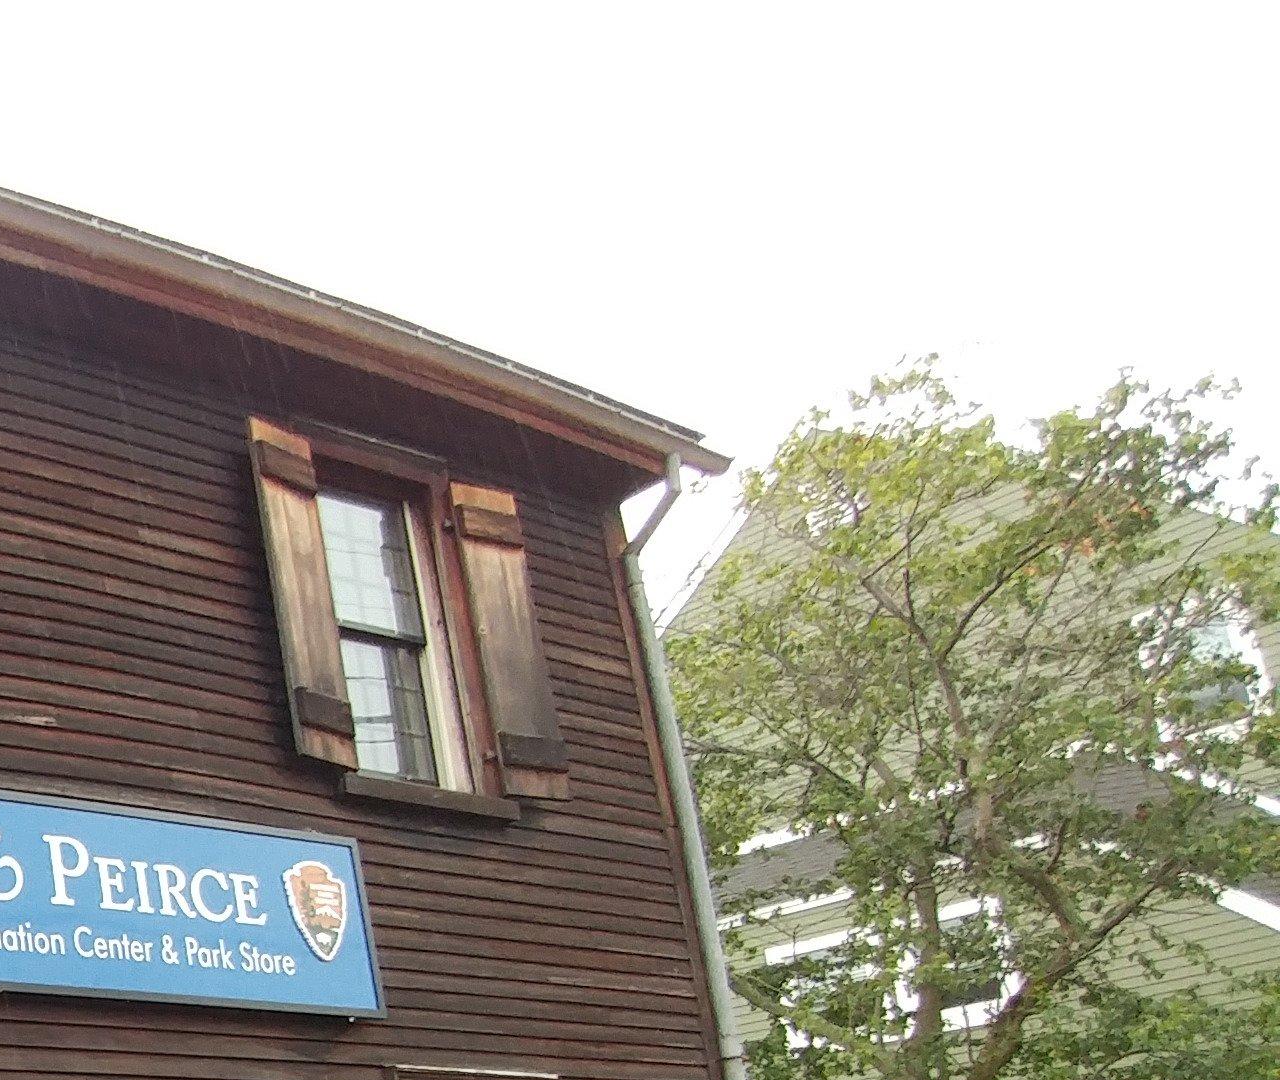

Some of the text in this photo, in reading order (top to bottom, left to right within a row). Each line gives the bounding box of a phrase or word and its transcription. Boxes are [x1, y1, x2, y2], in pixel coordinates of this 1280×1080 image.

[41, 834, 268, 926] PEIRCE
[73, 925, 153, 962] Center
[161, 934, 180, 965] &
[185, 936, 235, 970] Park
[240, 941, 296, 975] Store
